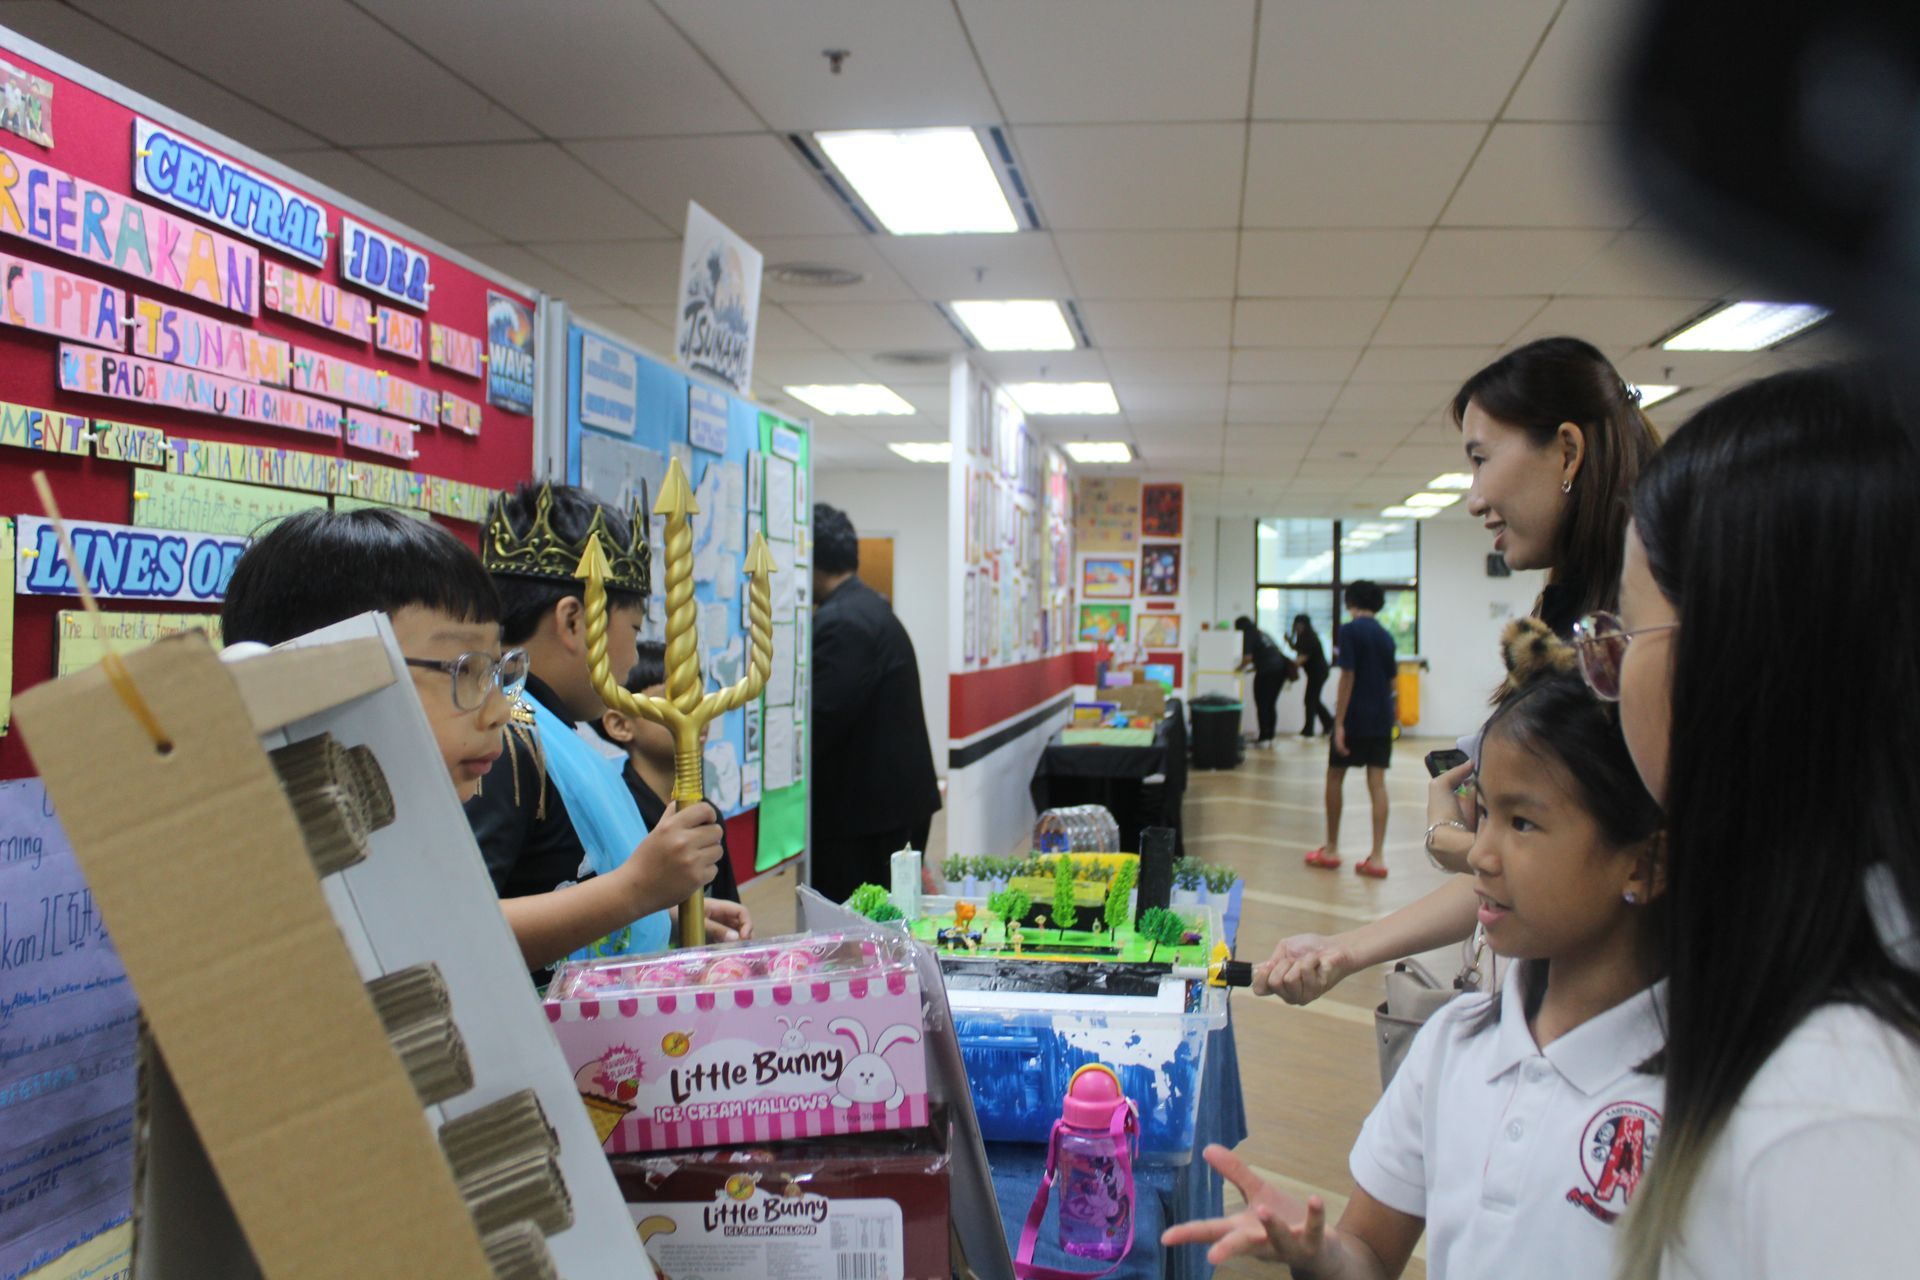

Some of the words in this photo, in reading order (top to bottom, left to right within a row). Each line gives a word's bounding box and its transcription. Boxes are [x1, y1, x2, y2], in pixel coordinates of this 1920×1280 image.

[144, 132, 323, 263] CENTRAL
[0, 264, 118, 341] CIPTA
[138, 300, 286, 385] TSUNAMI
[379, 310, 421, 354] JADI
[63, 351, 158, 399] KEPADA
[162, 369, 257, 417] MANUSIA
[295, 400, 336, 432] ALAM
[0, 404, 86, 452] MENT
[27, 523, 188, 597] LINES
[669, 1060, 748, 1105] Little
[751, 1045, 844, 1085] Bunny
[654, 1105, 683, 1125] ICE
[687, 1098, 744, 1122] CREAM
[746, 1093, 829, 1116] MALLOWS
[703, 1203, 759, 1232] Little
[762, 1197, 829, 1223] Bunny
[724, 1226, 738, 1237] ICE
[740, 1225, 770, 1237] CREAM
[771, 1224, 817, 1236] MALLOWS
